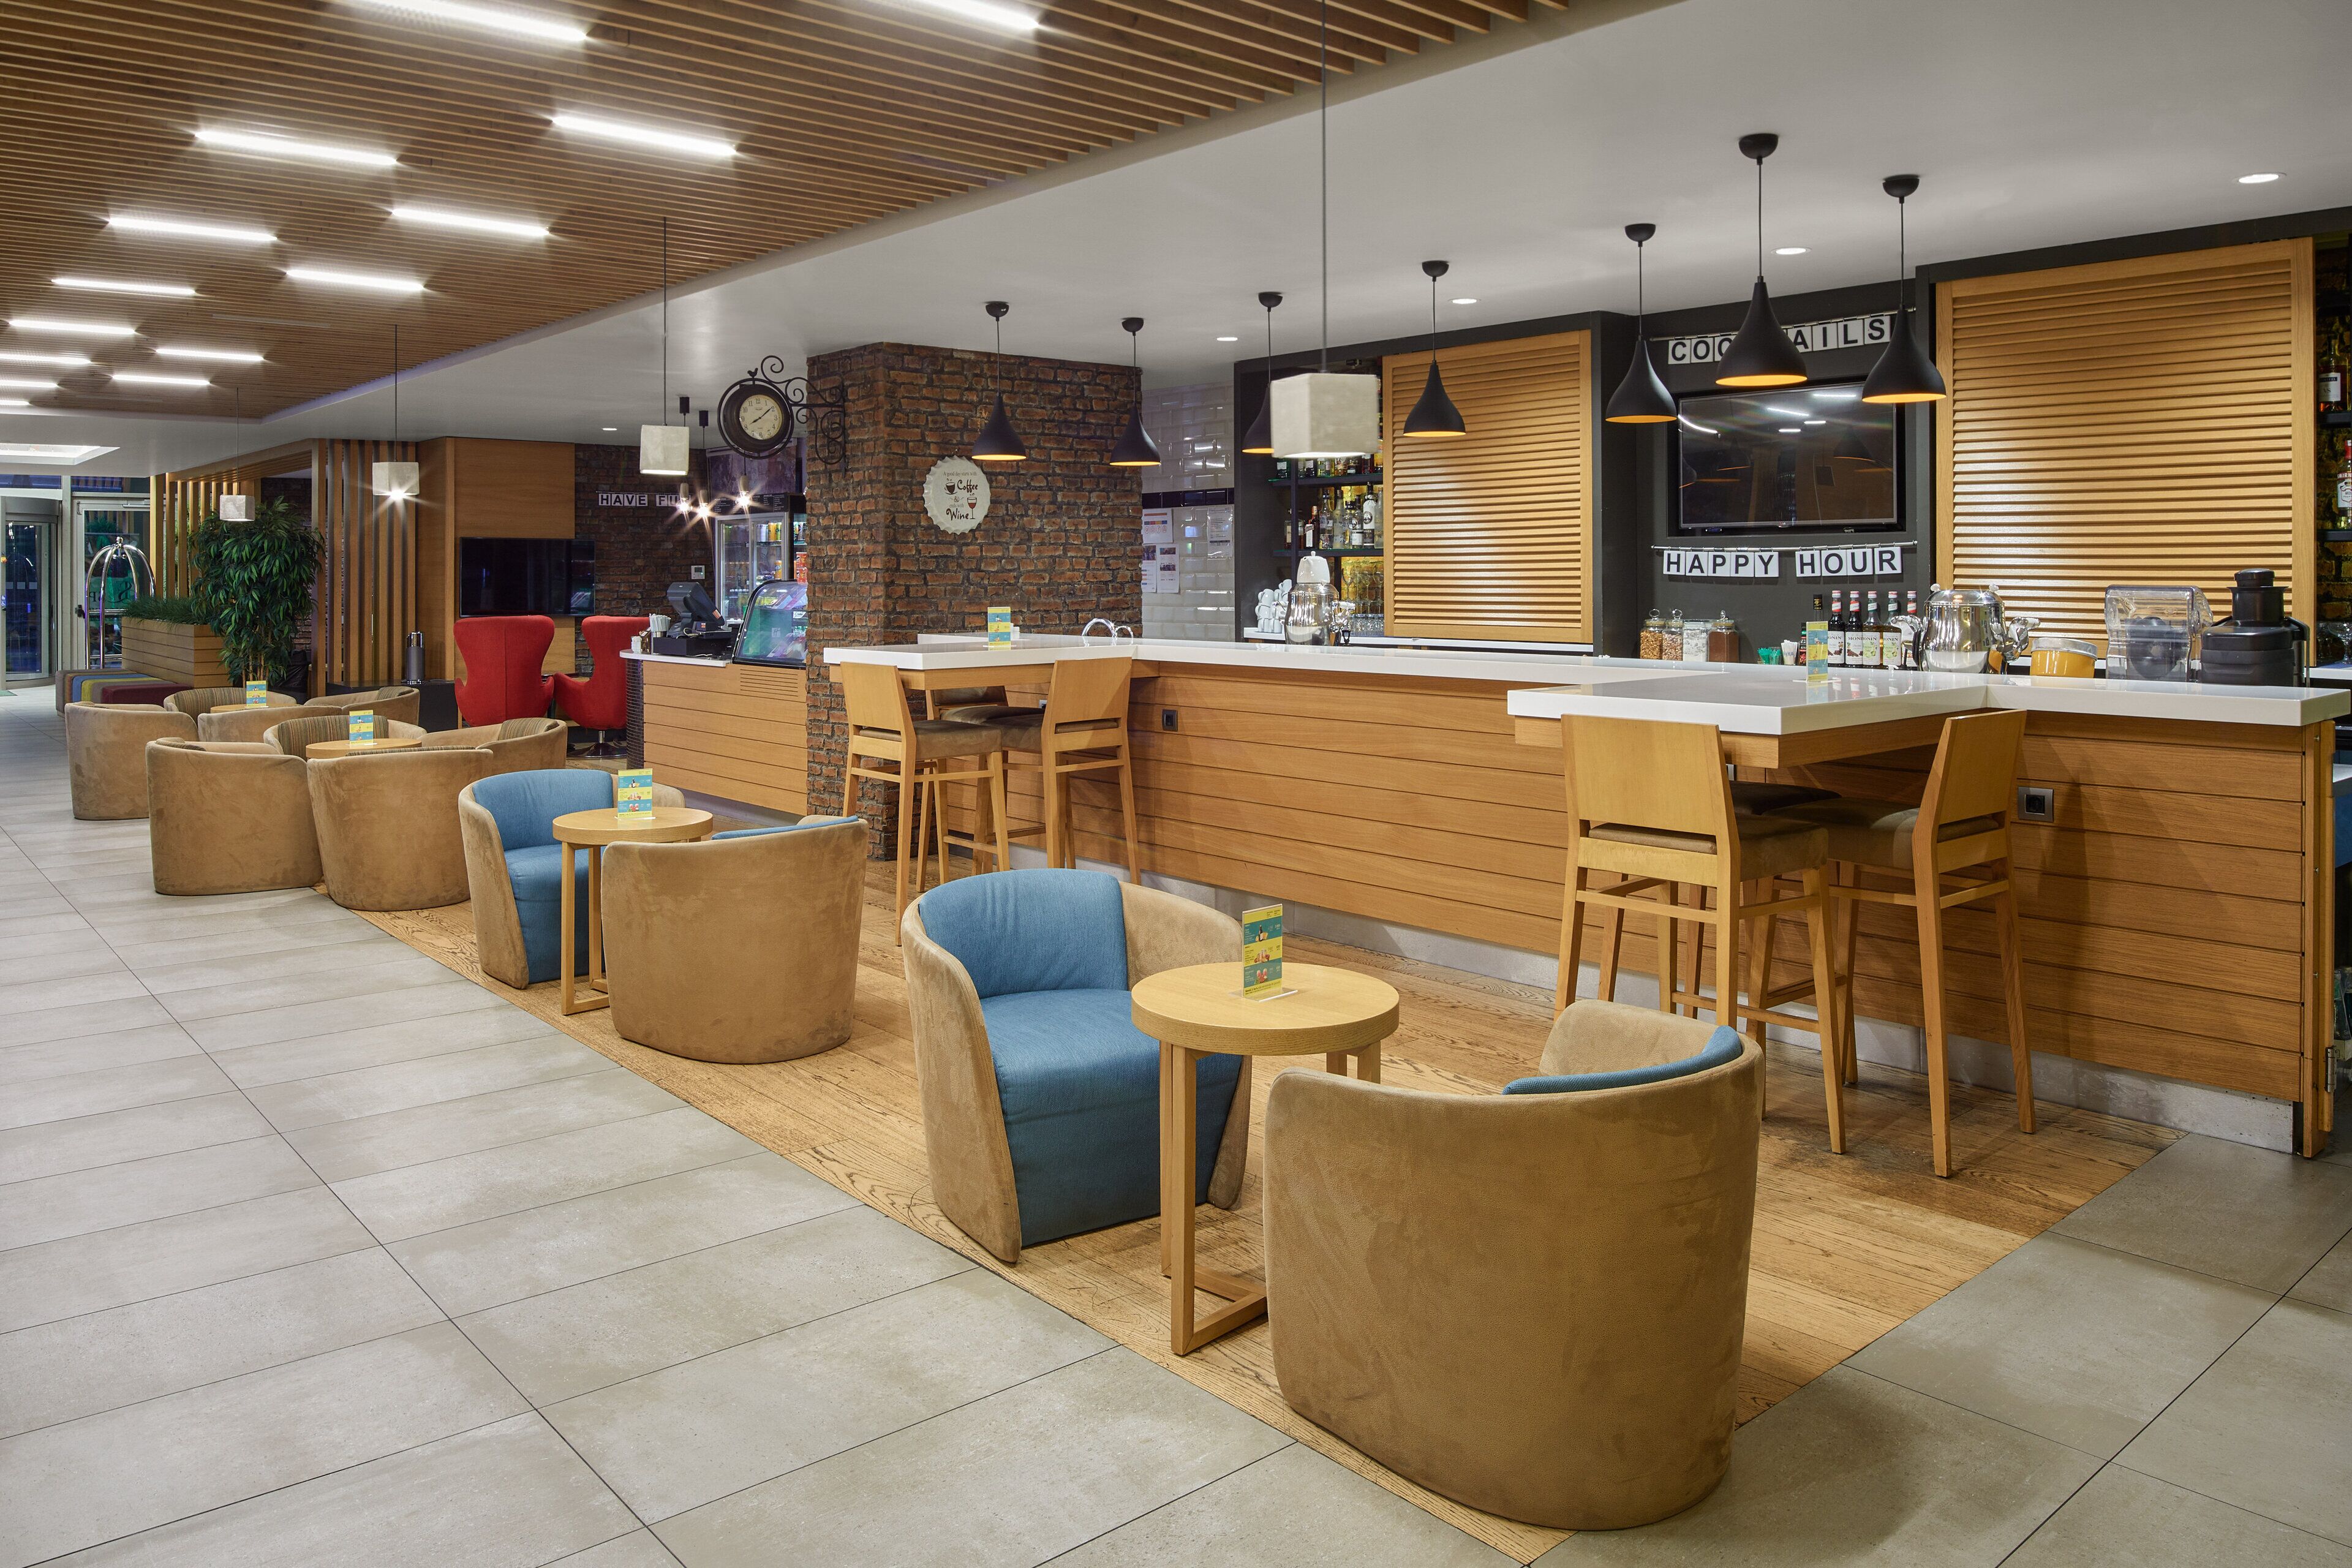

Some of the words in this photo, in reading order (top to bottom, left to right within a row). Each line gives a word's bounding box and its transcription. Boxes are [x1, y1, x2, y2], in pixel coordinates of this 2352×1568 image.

[1671, 319, 1885, 361] COCAILS
[957, 479, 978, 493] Coffee
[600, 494, 646, 505] HAVE
[659, 496, 686, 505] FU
[946, 508, 969, 521] Wine
[1667, 552, 1774, 575] HAPPY
[1800, 550, 1896, 575] HOUR
